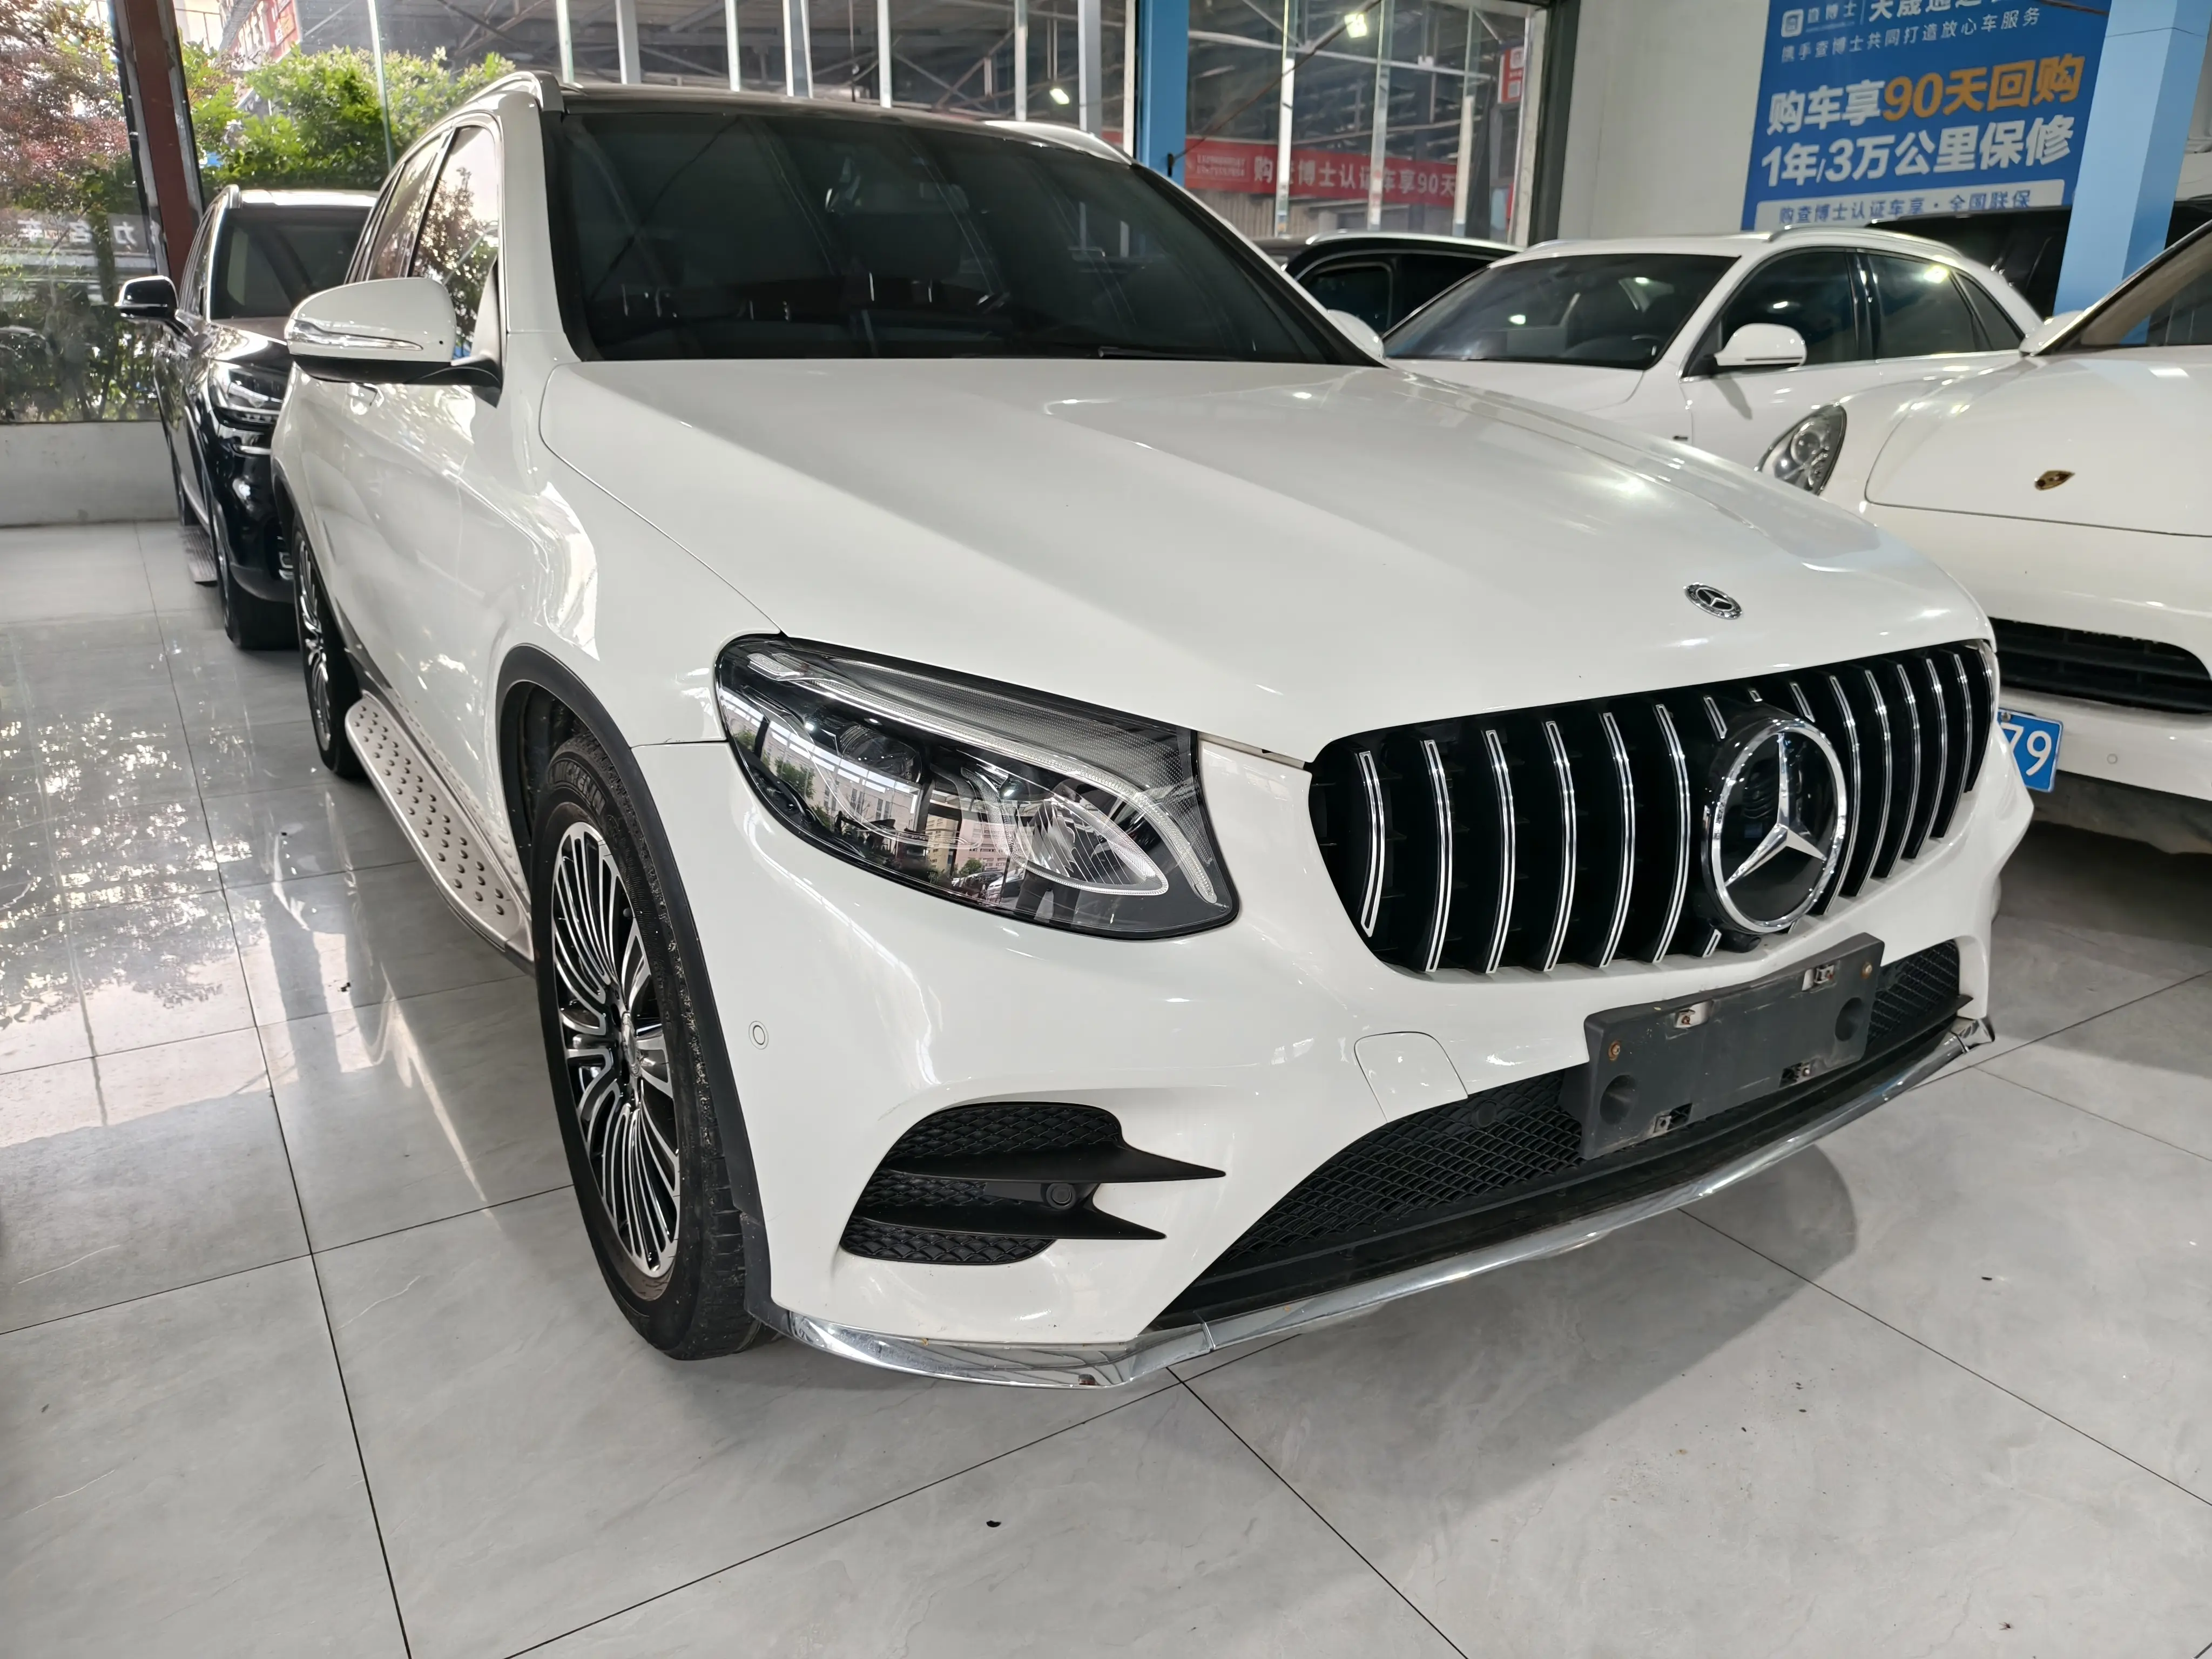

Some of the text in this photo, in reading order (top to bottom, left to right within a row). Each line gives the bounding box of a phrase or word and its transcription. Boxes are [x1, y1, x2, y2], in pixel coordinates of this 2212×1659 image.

[1766, 53, 2086, 136] 购车享90天回购
[1254, 156, 1456, 197] 购博士认证车享90天
